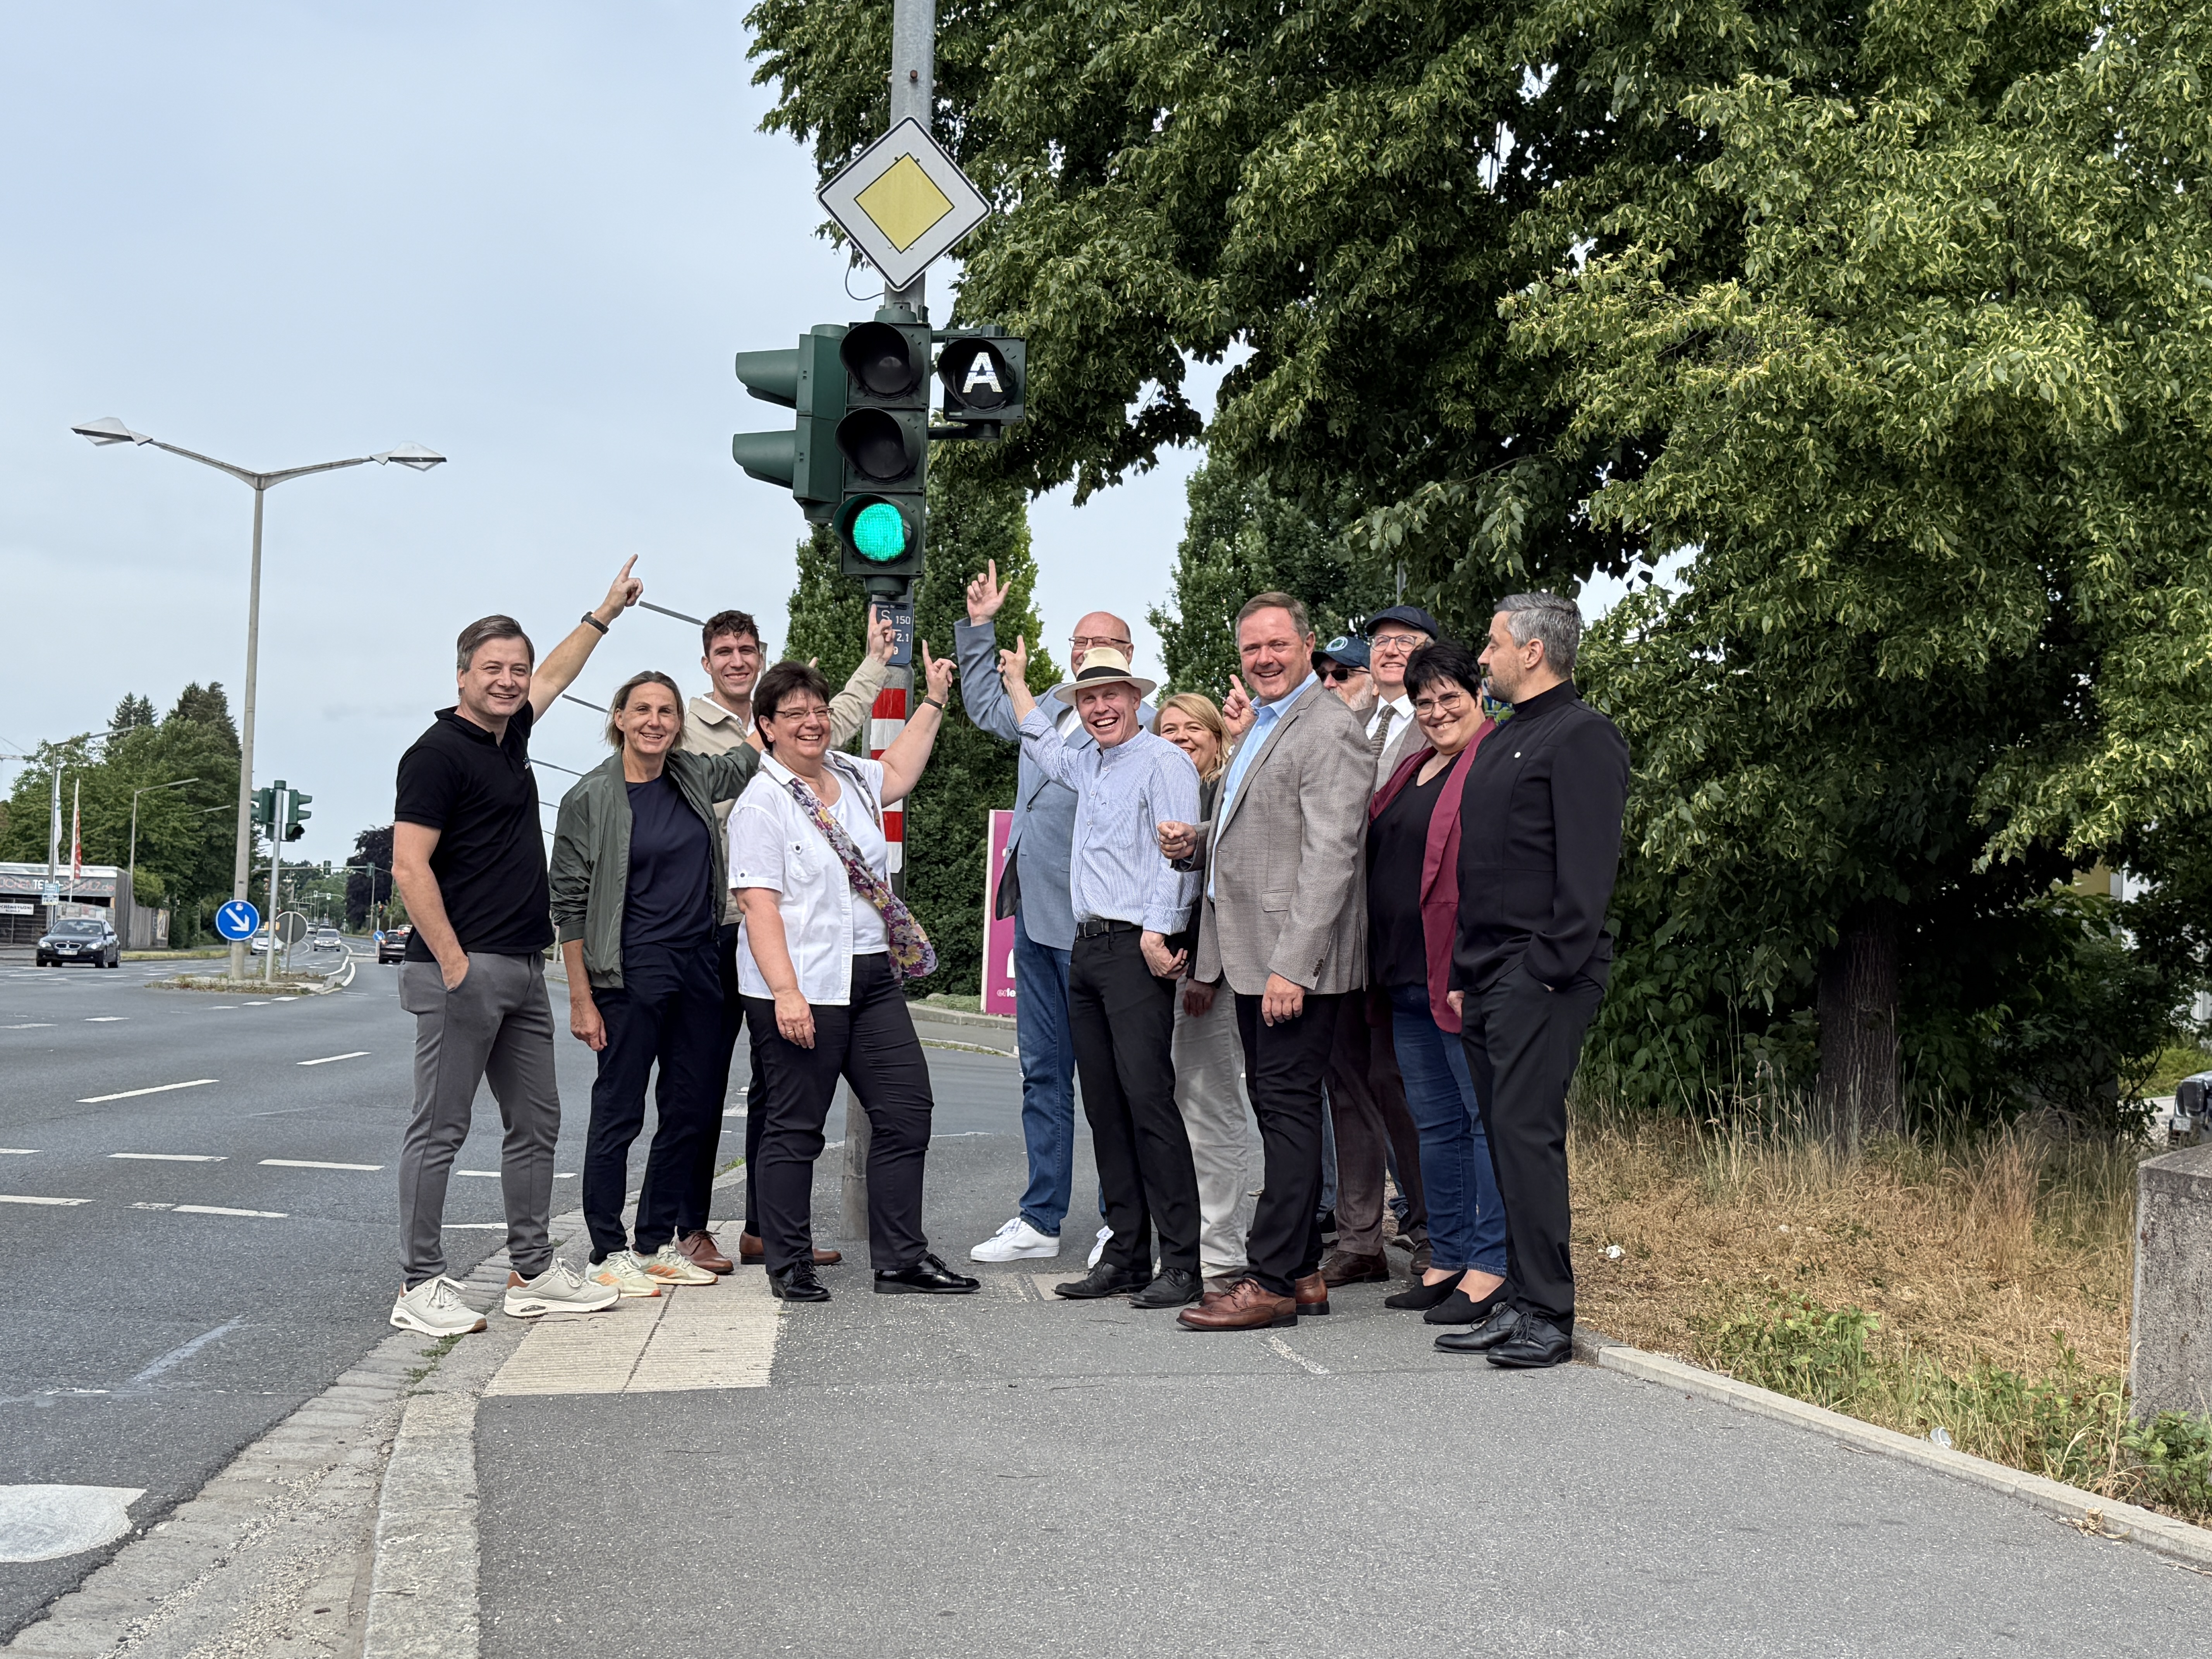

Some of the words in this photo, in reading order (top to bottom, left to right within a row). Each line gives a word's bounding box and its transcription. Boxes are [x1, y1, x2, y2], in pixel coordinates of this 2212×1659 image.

[962, 352, 1003, 393] A
[881, 610, 890, 620] S
[896, 615, 910, 624] 150
[896, 633, 909, 642] 2.1
